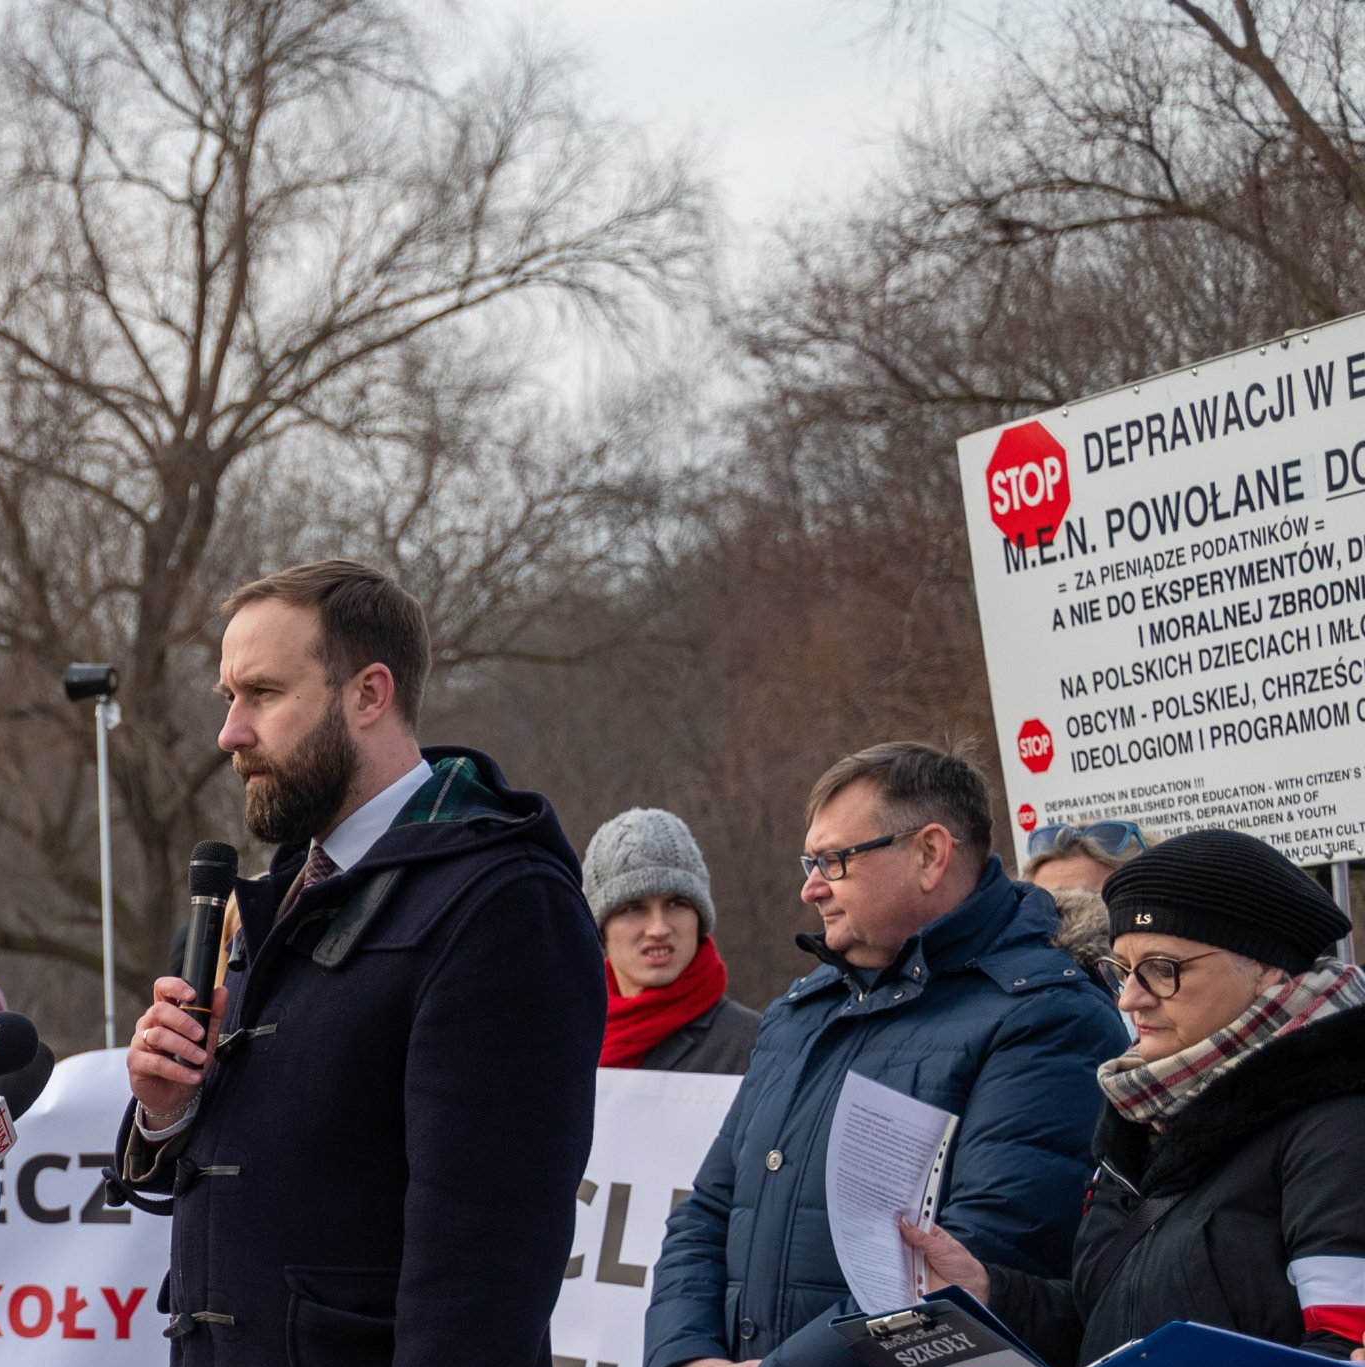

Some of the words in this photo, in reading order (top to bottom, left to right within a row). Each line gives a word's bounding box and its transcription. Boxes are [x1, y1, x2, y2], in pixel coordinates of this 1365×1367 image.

[1083, 373, 1295, 474] DEPRAWACJI
[1303, 360, 1334, 411] W
[991, 456, 1062, 515] STOP
[1002, 516, 1097, 575] M.E.N.
[1105, 459, 1304, 548] POWOŁANE
[1074, 570, 1096, 591] ZA
[1100, 546, 1186, 585] PIENIĄDZE
[1190, 515, 1309, 563] PODATNIKÓW
[1052, 607, 1066, 632] A
[1069, 598, 1102, 628] NIE
[1106, 591, 1136, 619] DO
[1141, 541, 1342, 611] EKSPERYMENTÓW,
[1347, 535, 1365, 563] D
[1138, 624, 1144, 648] I
[1149, 598, 1263, 646] MORALNEJ
[1060, 675, 1088, 700] NA
[1092, 652, 1192, 693] POLSKICH
[1198, 626, 1310, 672] DZIECIACH
[1317, 624, 1323, 648] I
[1066, 705, 1136, 739] OBCYM
[1152, 682, 1257, 722] POLSKIEJ,
[1262, 656, 1365, 702] CHRZEŚC
[1019, 733, 1051, 760] STOP
[1071, 730, 1194, 773] IDEOLOGIOM
[1199, 728, 1205, 751] I
[1209, 701, 1350, 750] PROGRAMOM
[1044, 791, 1116, 813] DEPRAVATION
[1119, 788, 1128, 801] IN
[1131, 779, 1192, 799] EDUCATION
[1194, 776, 1205, 789] !!!
[1079, 809, 1102, 822] WAS
[1104, 796, 1176, 819] ESTABLISHED
[1177, 794, 1199, 807] FOR
[1202, 783, 1265, 803] EDUCATION
[1274, 776, 1303, 792] WITH
[1197, 796, 1274, 820] DEPRAVATION
[1277, 793, 1301, 807] AND
[1303, 790, 1319, 803] OF
[1228, 811, 1283, 831] CHILDREN
[1286, 811, 1294, 822] &
[1298, 804, 1337, 819] YOUTH
[1270, 832, 1292, 846] THE
[1295, 825, 1333, 842] DEATH
